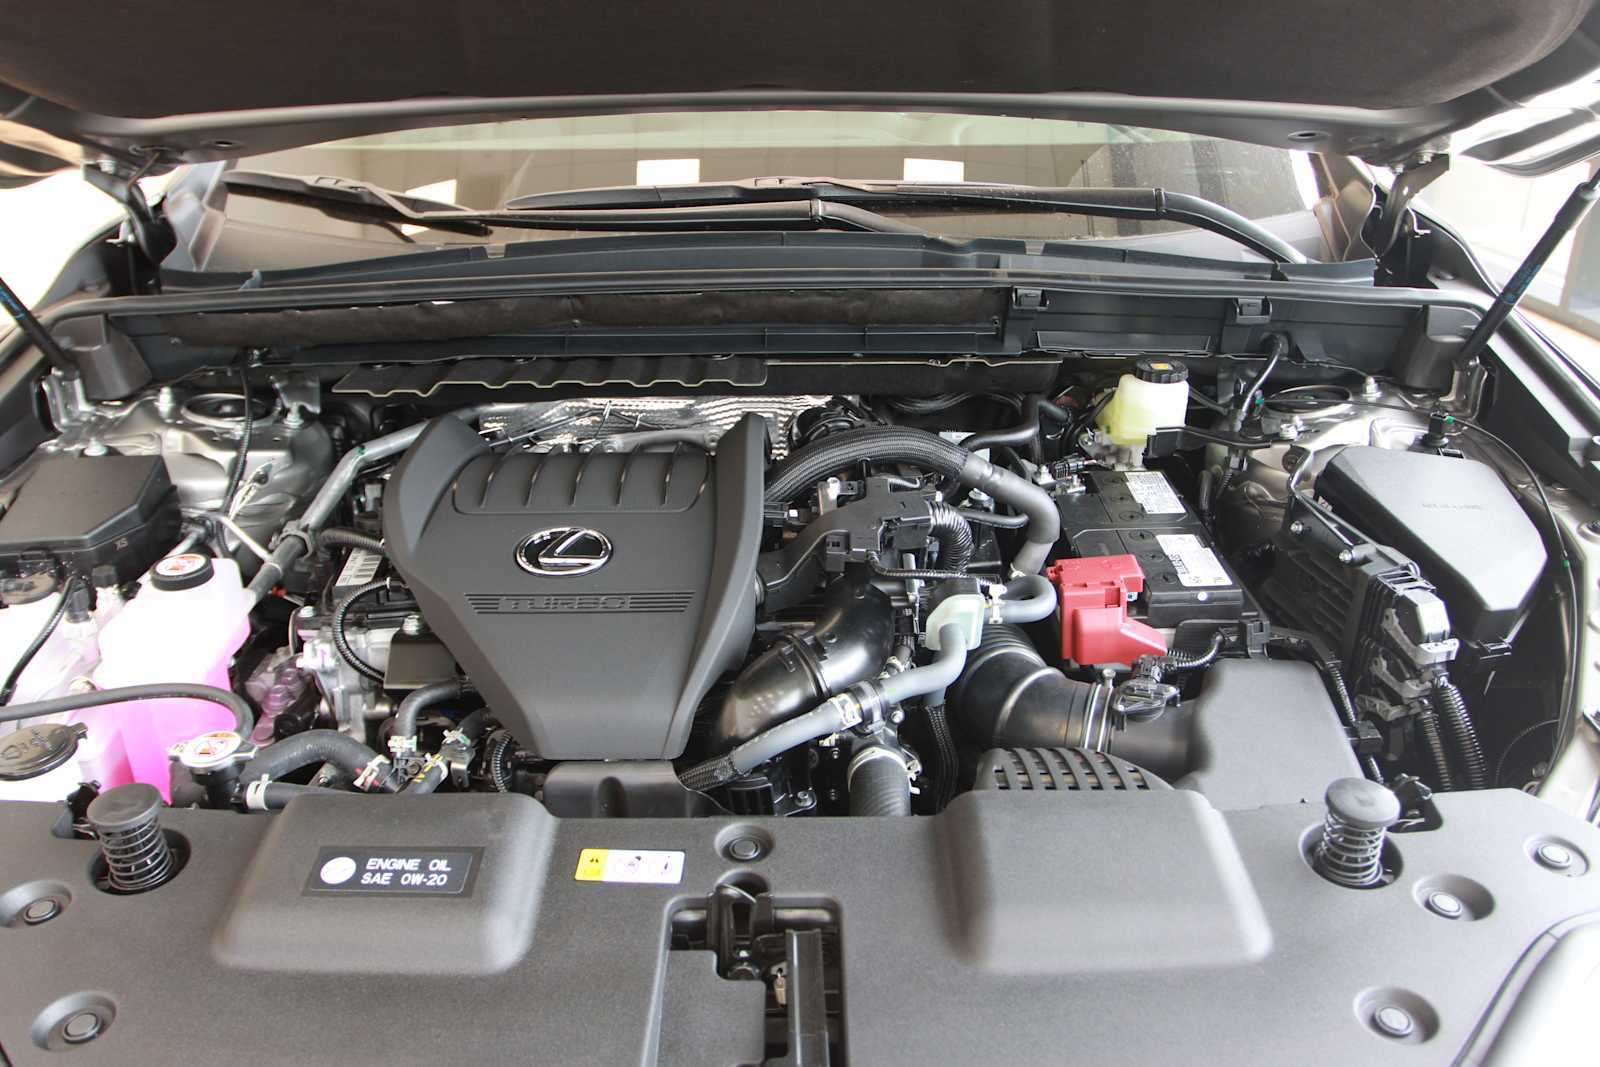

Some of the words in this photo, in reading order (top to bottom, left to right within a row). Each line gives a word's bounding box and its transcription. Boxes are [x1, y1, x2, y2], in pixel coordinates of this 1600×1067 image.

[502, 596, 627, 610] TURBO
[365, 857, 421, 871] ENGINE
[428, 859, 452, 872] OIL
[361, 872, 393, 885] SAE
[400, 873, 448, 886] 0W-20
